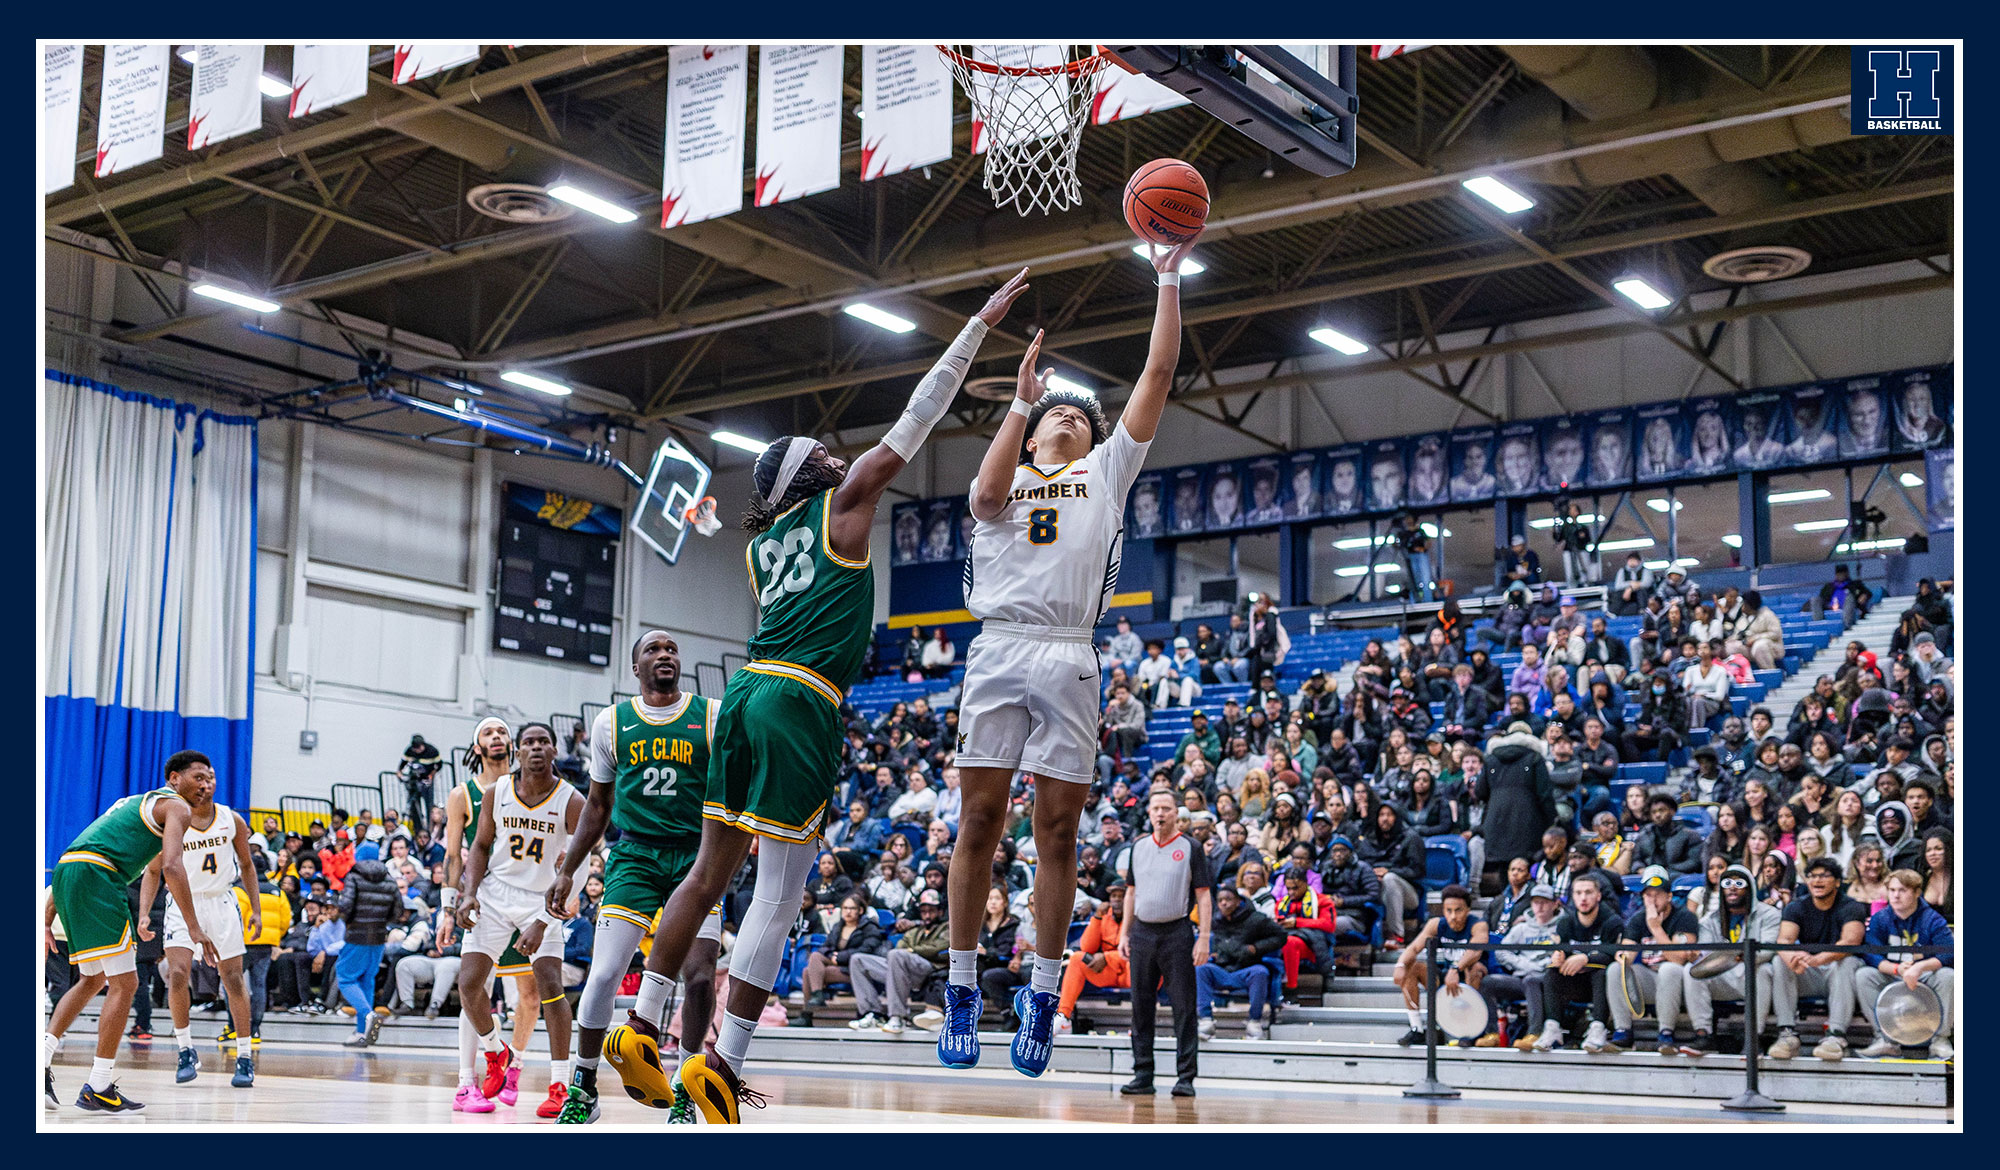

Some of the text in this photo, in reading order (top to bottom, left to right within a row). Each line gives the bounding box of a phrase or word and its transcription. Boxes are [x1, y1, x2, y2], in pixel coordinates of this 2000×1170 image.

[1028, 507, 1059, 546] 8
[758, 526, 815, 607] 23
[629, 737, 694, 766] ST. CLAIR
[642, 766, 678, 796] 22
[502, 816, 556, 834] HUMBER
[182, 835, 228, 852] HUMBER
[509, 834, 545, 864] 24
[201, 852, 218, 875] 4
